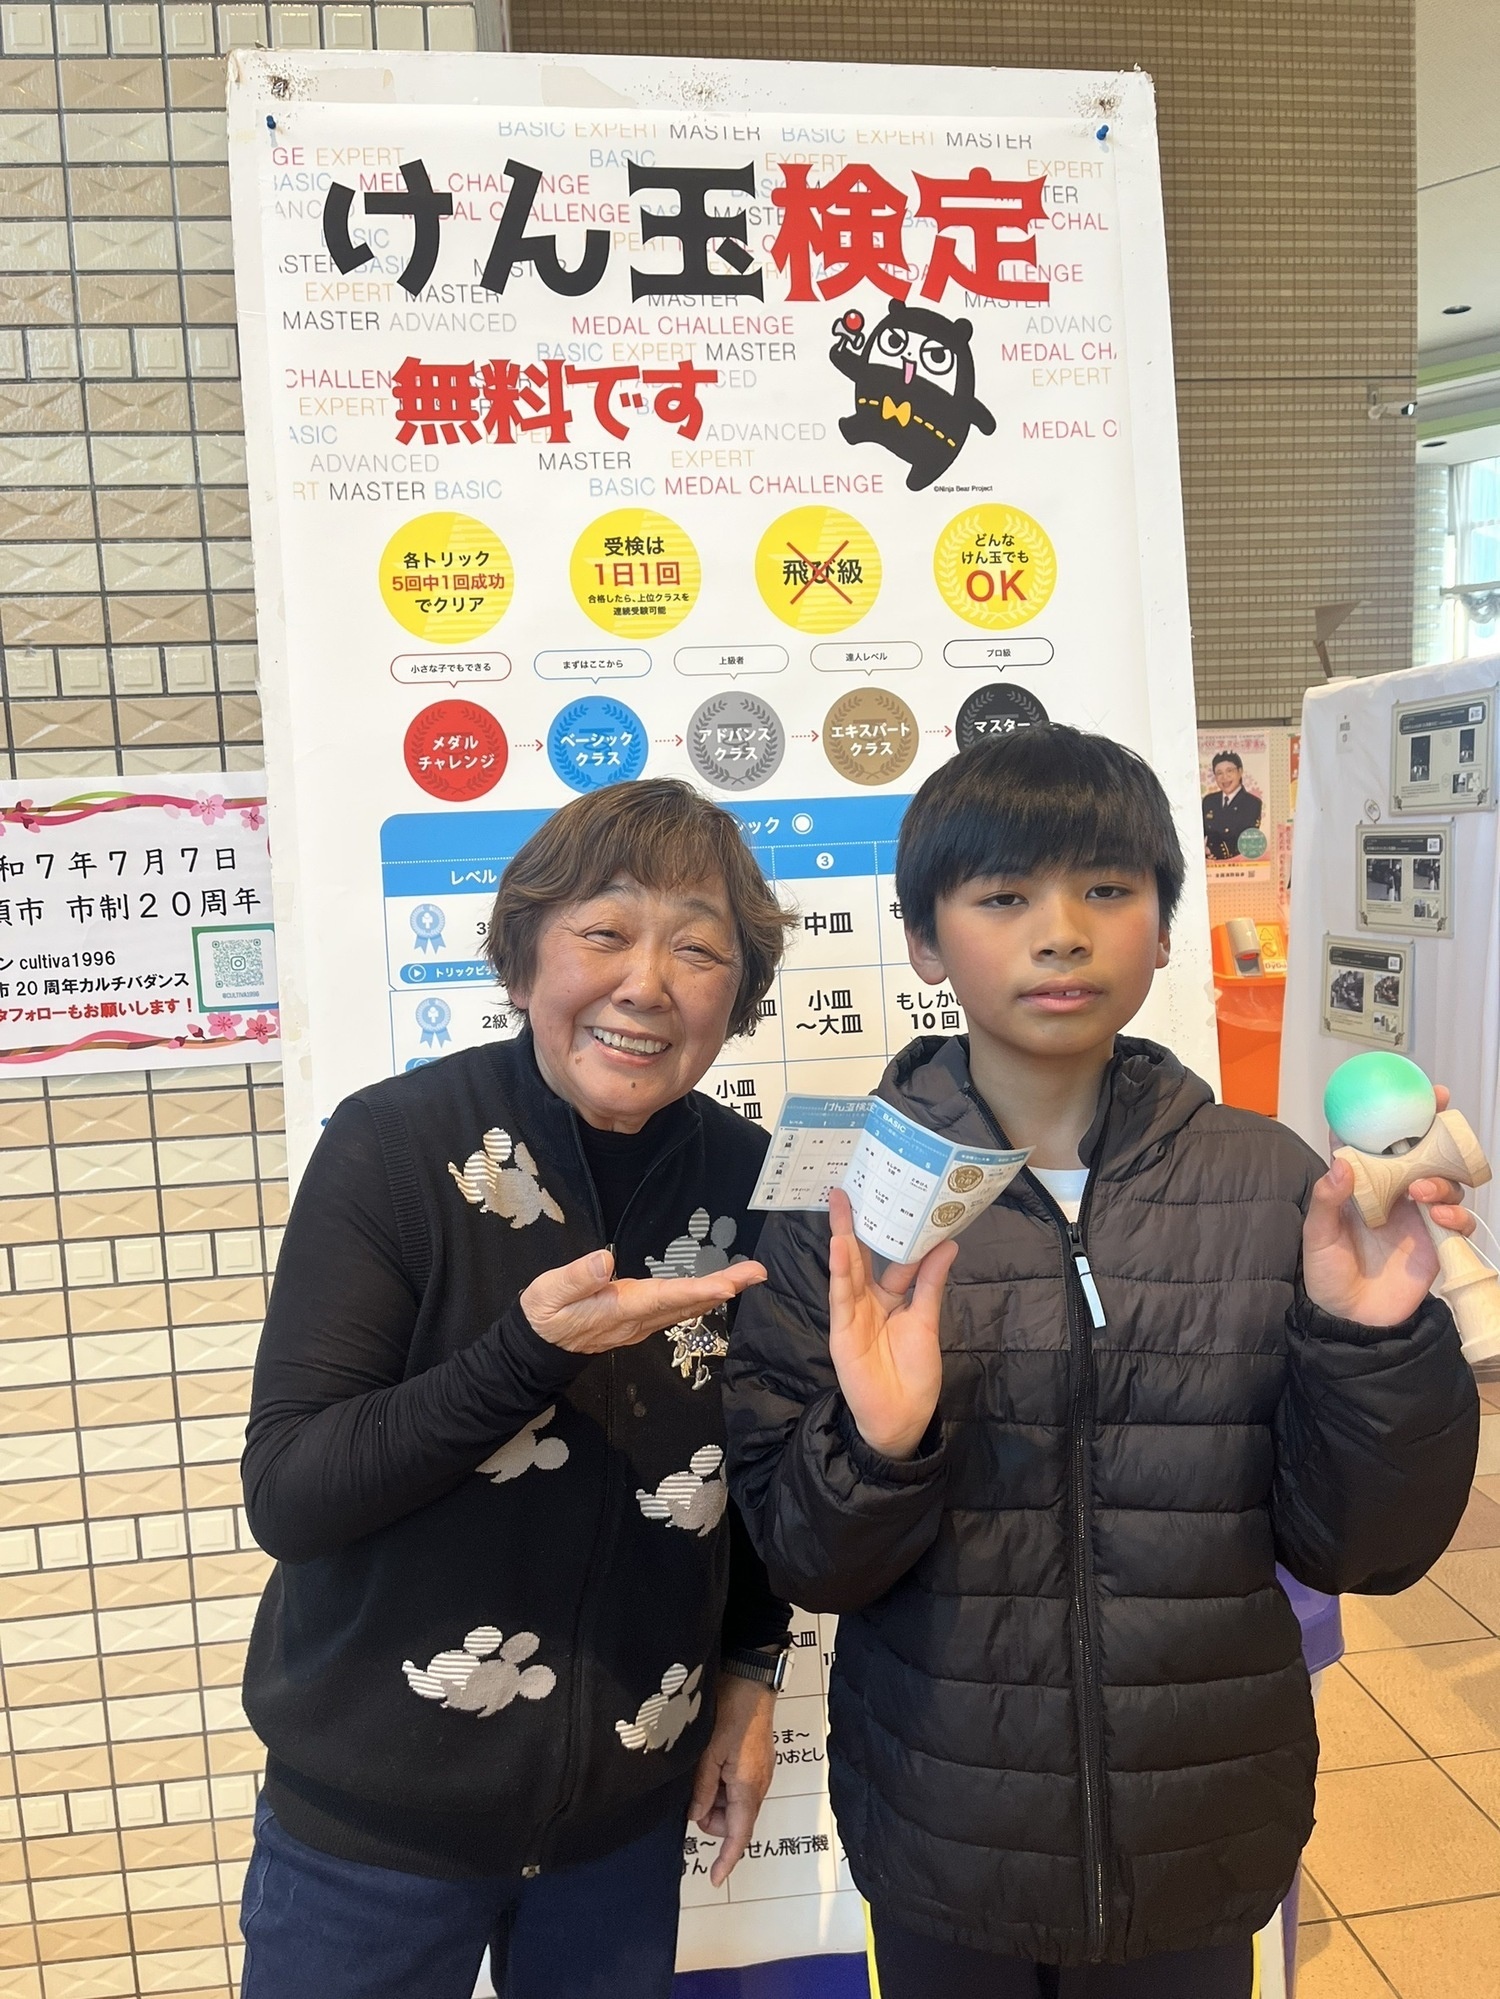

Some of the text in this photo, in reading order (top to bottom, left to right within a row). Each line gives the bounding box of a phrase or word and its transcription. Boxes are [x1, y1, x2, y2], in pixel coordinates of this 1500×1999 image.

[498, 122, 1033, 150] BASIC EXPERT MASTER BASIC EXPERT MASTER
[272, 148, 305, 166] GE
[316, 148, 405, 167] EXPERT
[590, 149, 656, 168] BASIC
[1027, 159, 1104, 178] EXPERT
[448, 173, 590, 195] CHALNGE
[490, 201, 631, 223] CALLENGE
[321, 228, 389, 248] SIC
[323, 159, 1050, 304] けん玉検定
[279, 255, 338, 273] STE
[305, 282, 394, 302] EXPERT
[283, 311, 380, 330] MASTER
[389, 313, 517, 332] ADVANCED
[572, 316, 650, 335] MEDAL
[657, 316, 794, 335] CHALLENGE
[536, 343, 1118, 362] BASIC EXPERT MASTER MEDAL CH
[285, 369, 392, 389] CHALLEN
[1032, 367, 1112, 386] EXPERT
[299, 397, 388, 416] EXPERT
[392, 356, 719, 447] 無料です
[706, 423, 826, 442] ADVANCED
[1022, 420, 1097, 439] MEDAL
[311, 450, 755, 473] ADVANCED MASTER EXPERT
[329, 481, 426, 501] MASTER
[435, 480, 502, 499] BASIC
[590, 478, 655, 497] BASIC
[665, 477, 743, 496] MEDAL
[749, 475, 884, 494] CHALLENGE
[604, 536, 665, 557] 受検は
[974, 533, 1015, 547] どんな
[403, 550, 490, 569] 各トリック
[962, 550, 1029, 565] けん玉でも
[594, 561, 681, 587] 1日1回
[782, 558, 863, 586] 飛び級
[392, 574, 505, 592] 5回中1回成功
[966, 569, 1027, 603] OK
[415, 596, 485, 614] でクリア
[587, 592, 690, 604] 合格したら、上位クラスを
[718, 655, 745, 666] 上級者
[846, 651, 888, 662] 達人レベル
[986, 648, 1011, 658] プロ級
[411, 662, 492, 674] 小さな子でもできる
[562, 658, 624, 669] まずはここから
[699, 726, 772, 743] アドバンス
[831, 721, 910, 739] エキスパート
[974, 718, 1031, 733] マスター
[433, 735, 479, 751] メダル
[560, 731, 633, 748] ベーシック
[850, 741, 893, 757] クラス
[418, 753, 495, 771] チャレンジ
[576, 751, 621, 767] クラス
[714, 746, 758, 761] クラス
[450, 869, 497, 886] レベル
[804, 911, 853, 936] 中皿
[20, 951, 116, 970] cultiva1996
[16, 980, 38, 996] 20
[807, 989, 853, 1011] 小皿
[482, 1015, 508, 1030] 2級
[716, 1079, 756, 1098] 小皿
[883, 1112, 907, 1133] BASIC
[740, 1834, 829, 1859] せん飛行機
